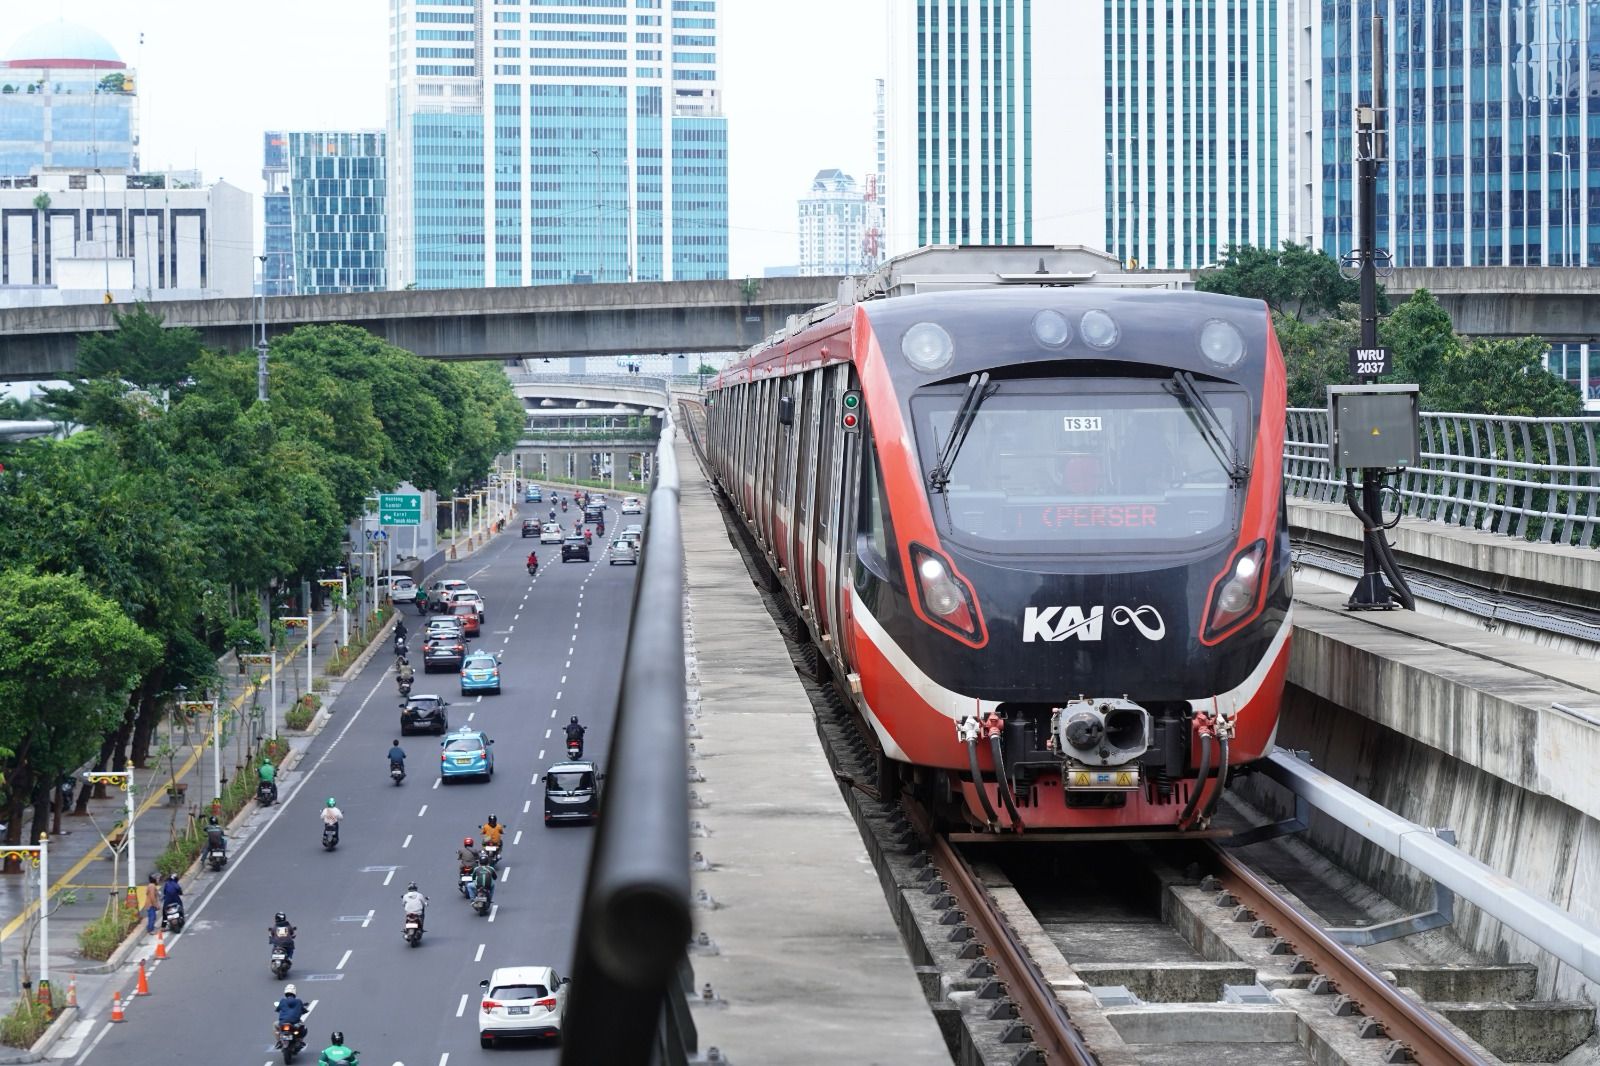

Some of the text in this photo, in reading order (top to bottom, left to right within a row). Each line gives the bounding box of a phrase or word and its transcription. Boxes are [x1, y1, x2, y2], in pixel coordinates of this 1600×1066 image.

[1357, 349, 1385, 361] WRU
[1357, 362, 1385, 374] 2037
[1066, 418, 1099, 430] TS 31
[1022, 605, 1104, 643] KAI
